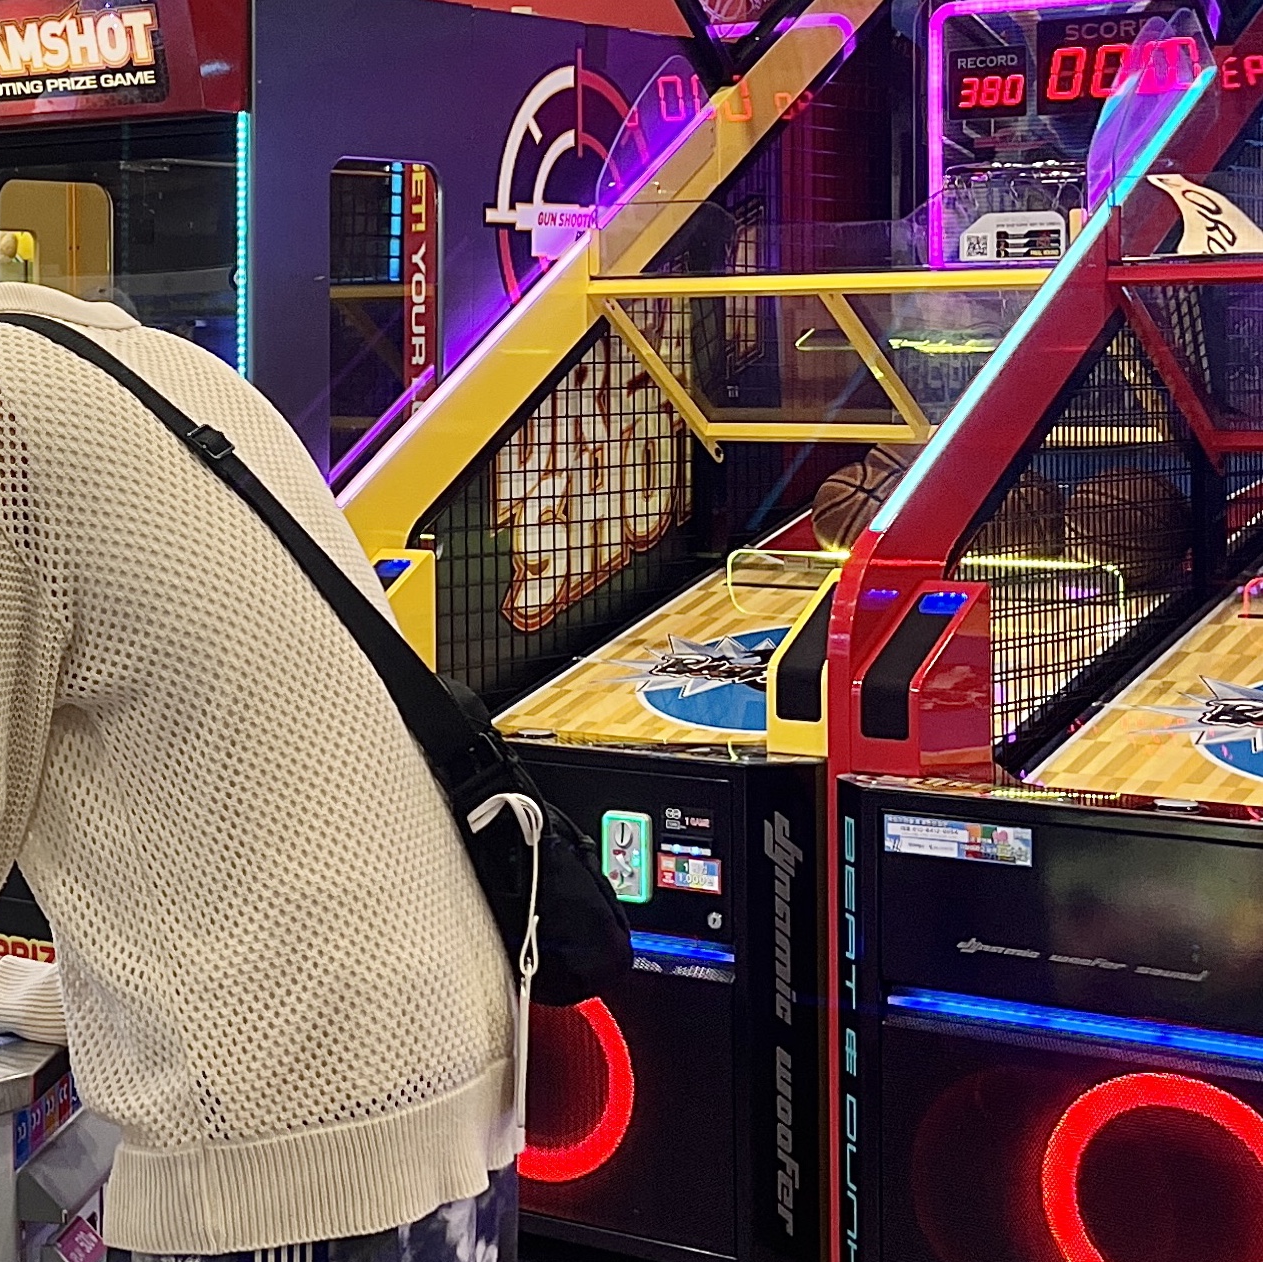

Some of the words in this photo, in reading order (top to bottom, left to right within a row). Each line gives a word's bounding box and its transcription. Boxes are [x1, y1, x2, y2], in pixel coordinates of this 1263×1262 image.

[46, 74, 98, 93] PRIZE
[100, 70, 157, 89] GAME
[957, 54, 1019, 70] RECORD
[958, 74, 1025, 108] 380
[538, 212, 558, 226] GUN
[411, 240, 427, 366] YOUR
[763, 810, 804, 1026] dynamic
[844, 815, 857, 1010] BEAT
[775, 1045, 800, 1238] woofer
